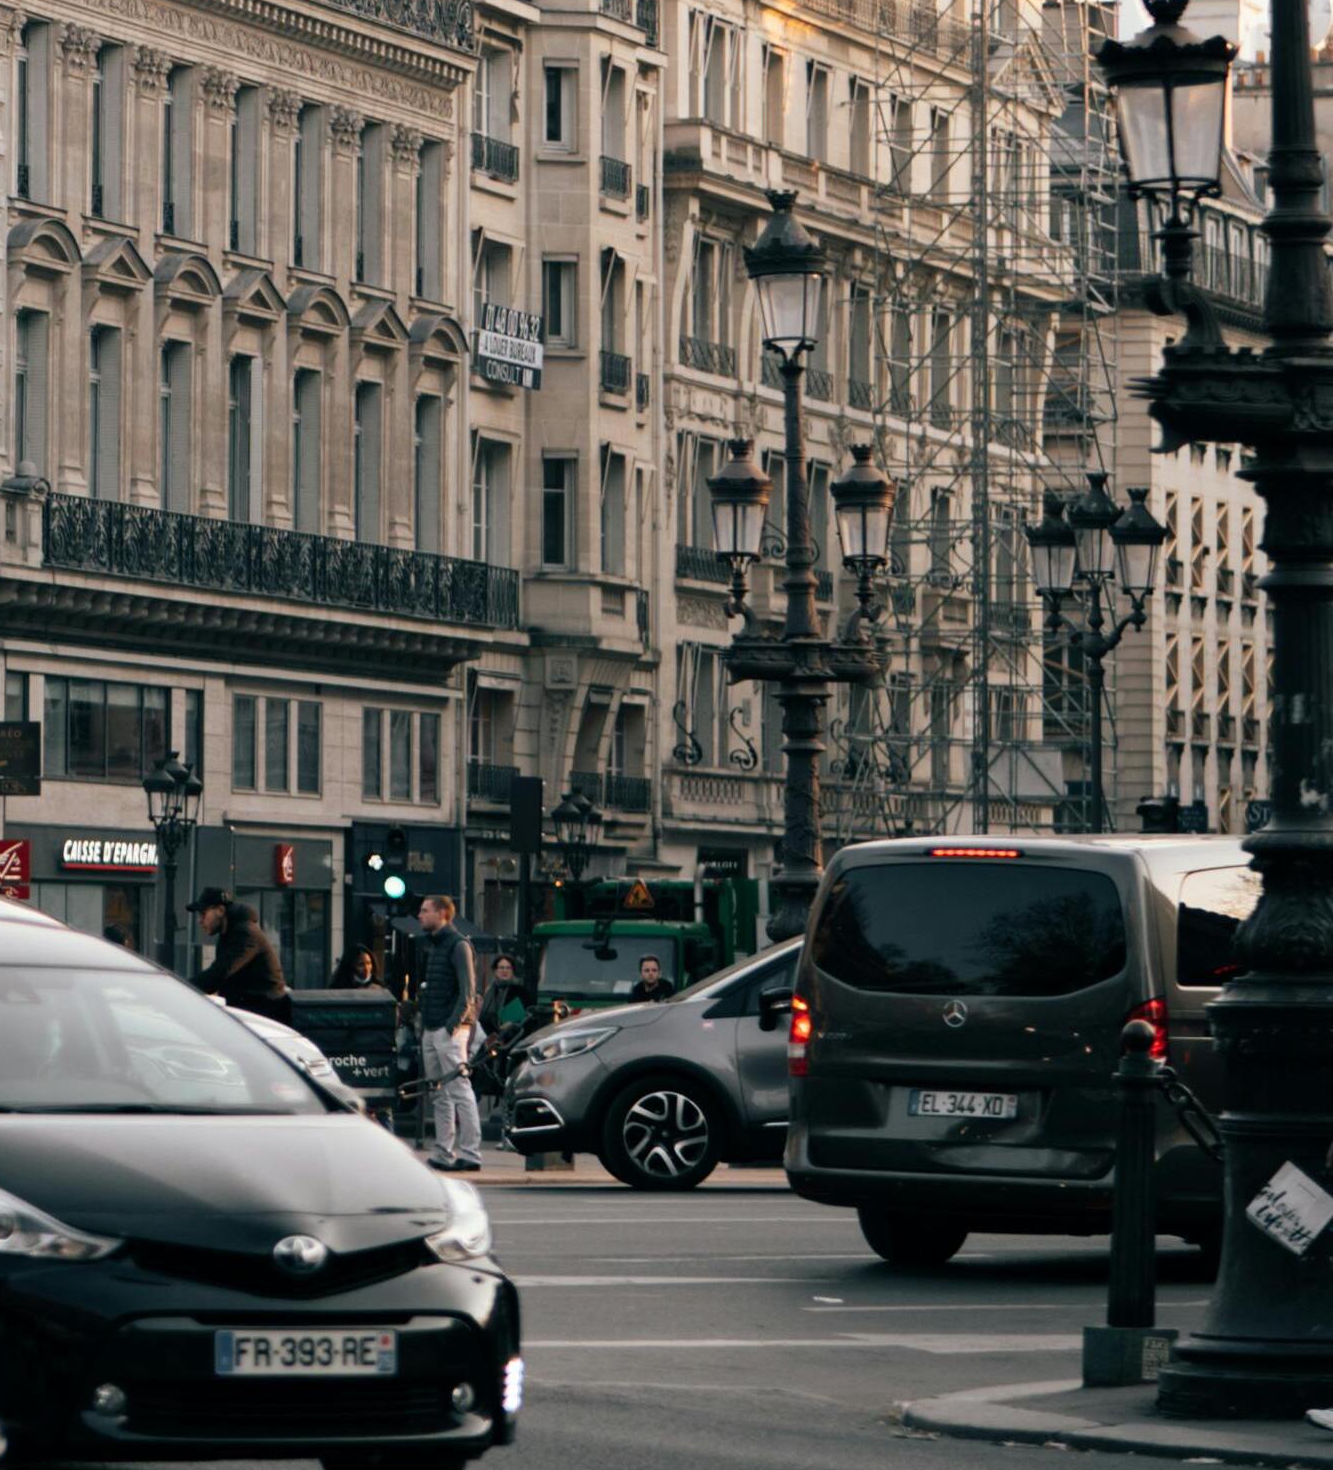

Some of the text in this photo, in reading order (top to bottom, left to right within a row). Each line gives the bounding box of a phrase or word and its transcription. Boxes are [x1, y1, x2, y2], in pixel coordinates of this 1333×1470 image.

[63, 839, 159, 866] CAISSE D'EPARGN
[328, 1054, 367, 1067] roche
